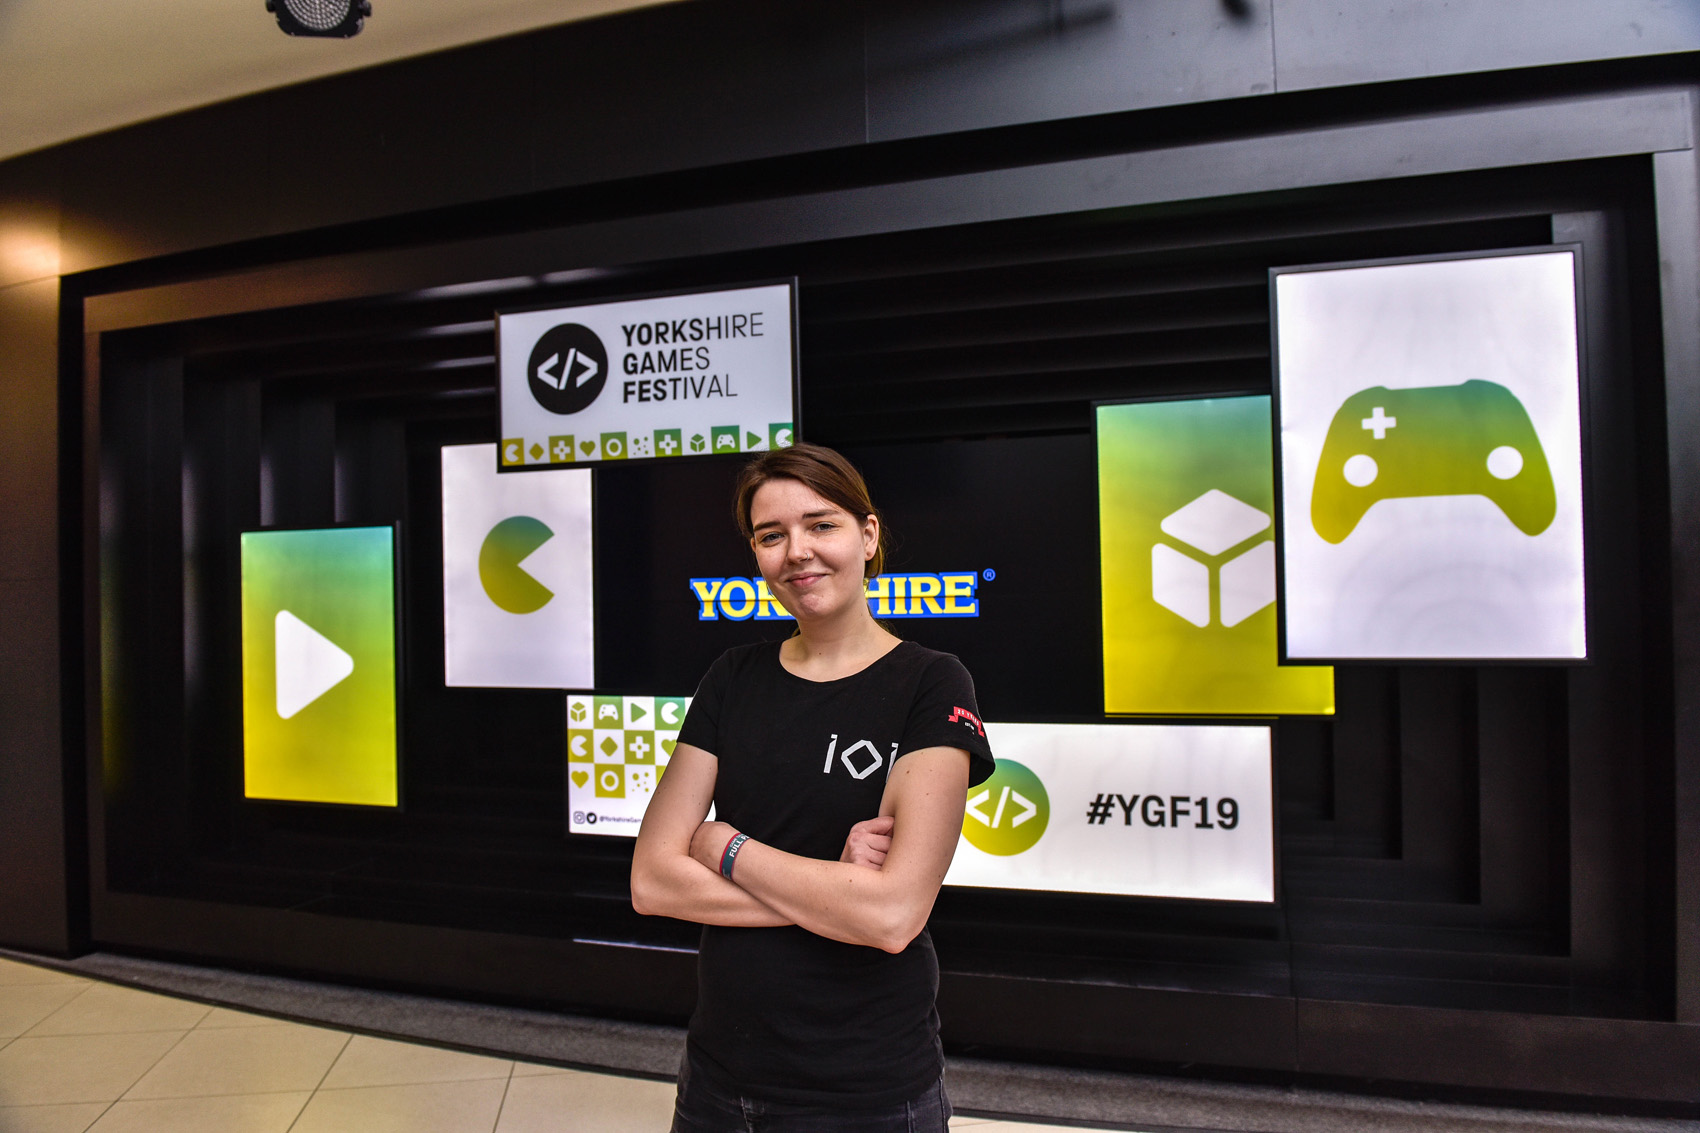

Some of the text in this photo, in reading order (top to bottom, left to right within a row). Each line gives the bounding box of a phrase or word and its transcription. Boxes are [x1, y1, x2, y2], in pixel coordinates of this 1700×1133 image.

[621, 312, 764, 347] YORKSHIRE
[623, 346, 710, 375] GAMES
[623, 374, 738, 403] FESTIVAL
[690, 571, 979, 621] YORHIRE
[1086, 793, 1240, 831] #YGF19
[729, 840, 744, 858] FULL
